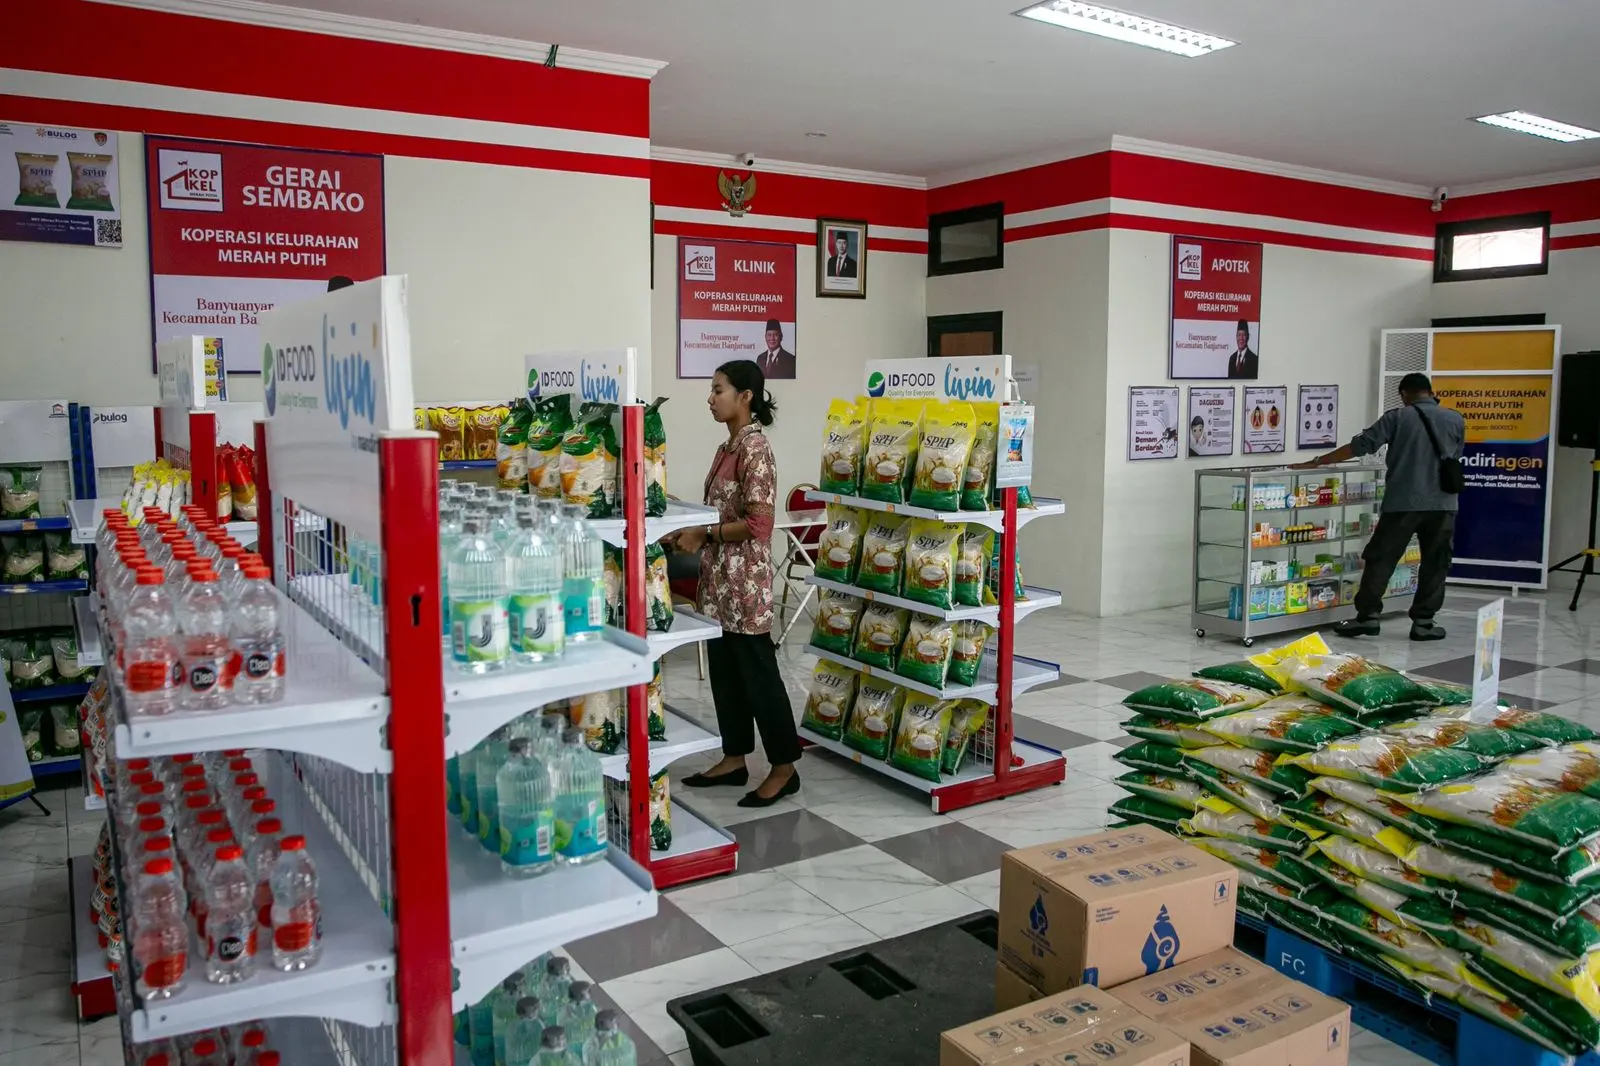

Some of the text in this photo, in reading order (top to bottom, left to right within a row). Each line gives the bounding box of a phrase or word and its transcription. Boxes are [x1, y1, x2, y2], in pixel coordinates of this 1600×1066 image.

[47, 130, 77, 138] BULOG
[188, 168, 218, 180] KOP
[266, 164, 340, 190] GERAI
[189, 180, 216, 192] KEL
[242, 186, 364, 213] SEMBAKO
[181, 228, 359, 249] KOPERASI KELURAHAN
[218, 249, 326, 266] MERAH PUTIH
[700, 262, 712, 270] KEL
[734, 260, 776, 274] KLINIK
[1211, 258, 1250, 274] APOTEK
[694, 290, 783, 303] KOPERASI KELURAHAN
[1184, 290, 1251, 302] KOPERASI KELURAHAN
[196, 298, 274, 314] Banyuanyar
[712, 303, 766, 313] MERAH PUTIH
[1197, 303, 1238, 312] MERAH PUTIH
[162, 312, 236, 325] Kecamatan
[700, 332, 739, 344] Banyuanyar
[1188, 332, 1217, 344] Banyuanyar
[684, 340, 756, 352] Kecamatan Banjarsari
[1175, 341, 1203, 350] Kecamatan
[276, 345, 316, 382] ID FOOD
[541, 371, 575, 387] ID FOOD
[888, 373, 936, 387] ID FOOD
[100, 412, 128, 423] bulog
[924, 436, 955, 449] SPHP
[1458, 453, 1543, 472] ndiriagen
[1280, 952, 1306, 976] FC
